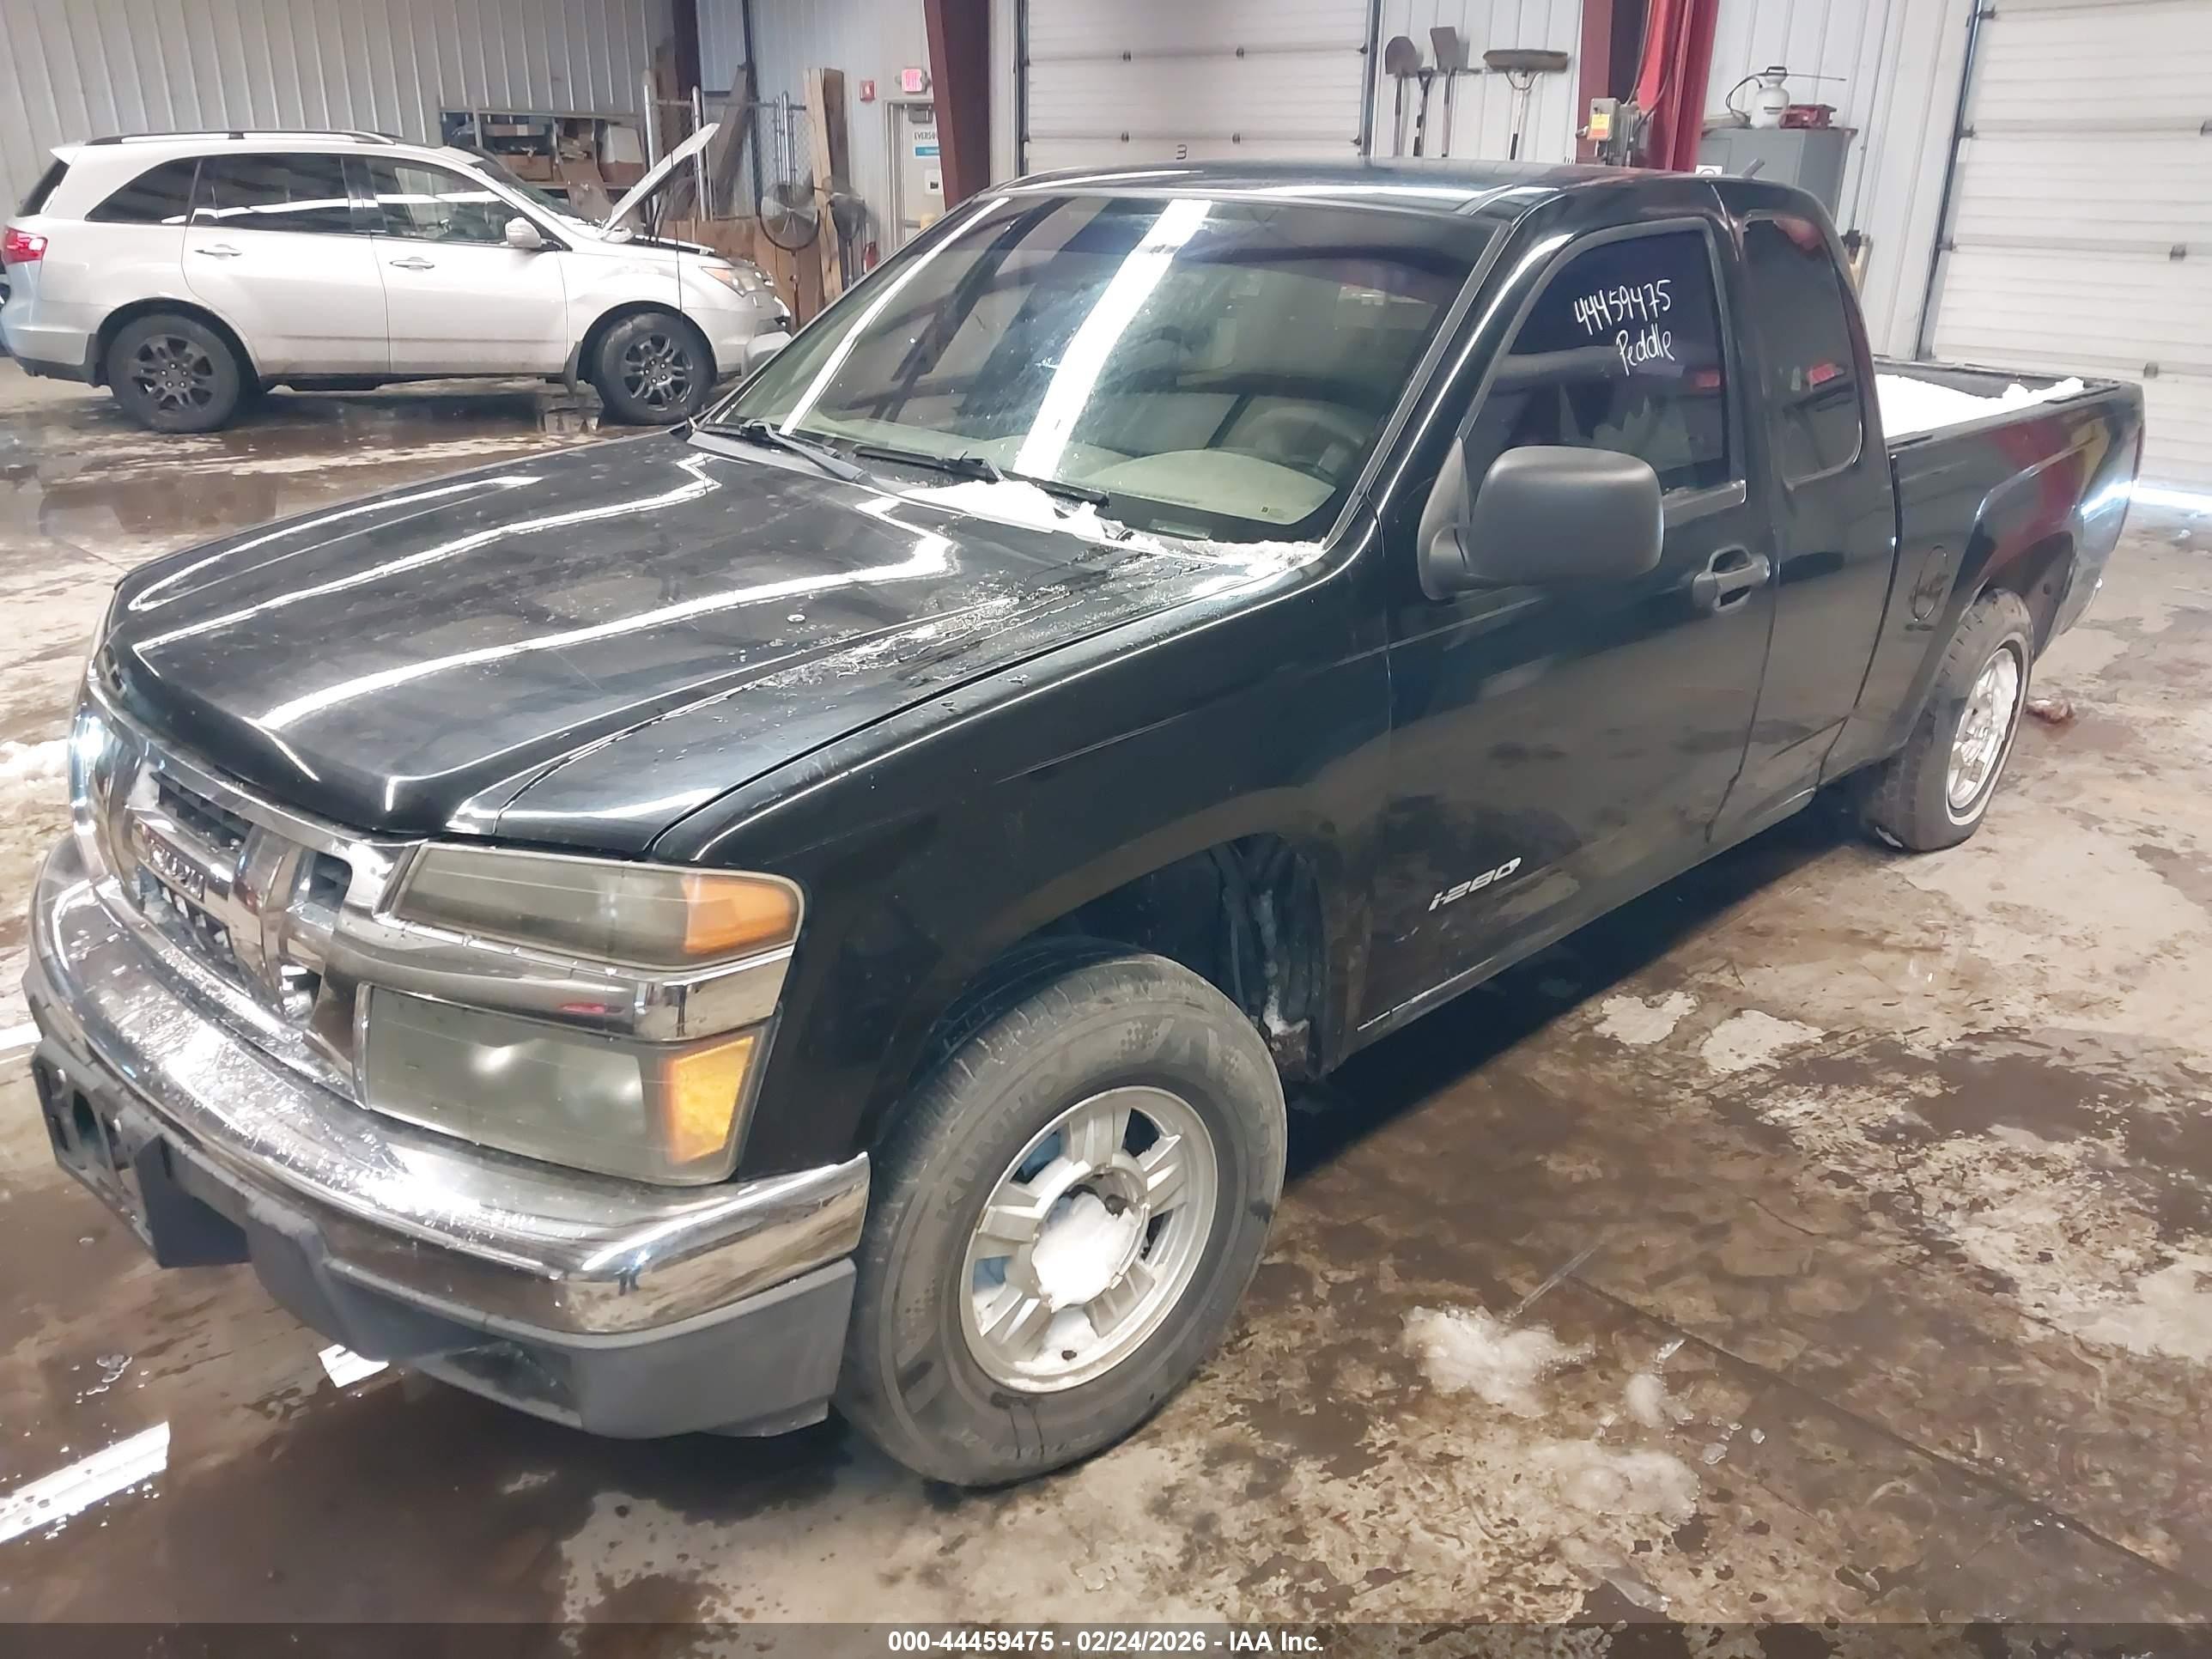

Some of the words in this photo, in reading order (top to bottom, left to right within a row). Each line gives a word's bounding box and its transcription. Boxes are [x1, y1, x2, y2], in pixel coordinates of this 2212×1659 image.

[1176, 143, 1188, 161] 3
[1574, 279, 1671, 336] 44459475
[1616, 323, 1675, 376] Peddle
